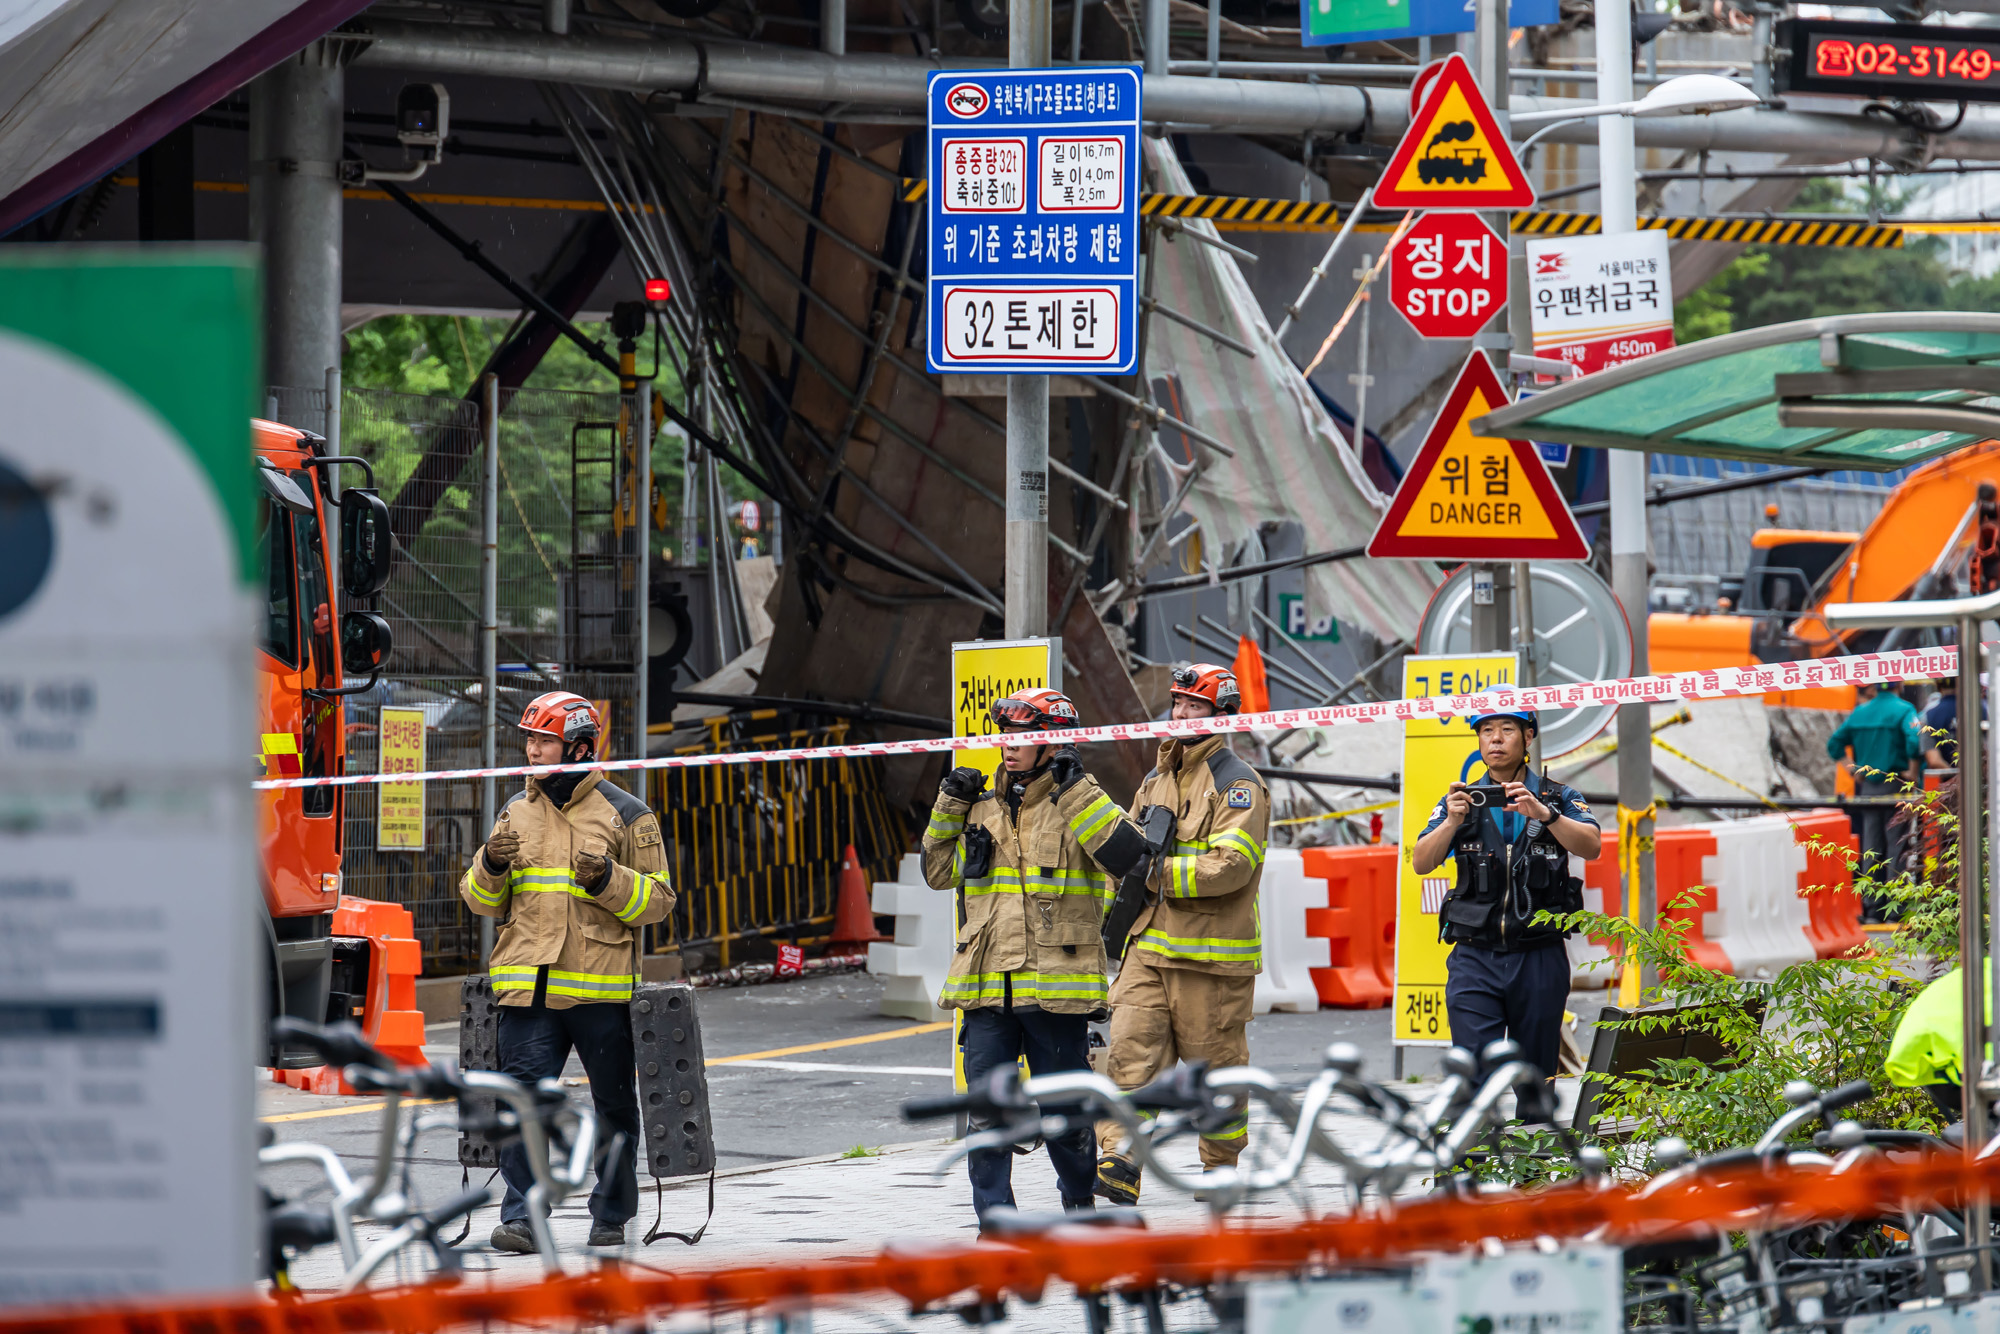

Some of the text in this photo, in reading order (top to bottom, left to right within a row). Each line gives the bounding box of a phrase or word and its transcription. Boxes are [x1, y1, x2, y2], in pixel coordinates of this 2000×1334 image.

[943, 223, 1122, 263] 위 기준 초과차량 제한
[1406, 233, 1490, 280] 정지
[1598, 258, 1659, 277] 서울미근동
[1406, 288, 1491, 317] STOP
[1535, 280, 1659, 318] 우편취급국
[1608, 340, 1657, 357] 450m
[1440, 455, 1509, 497] 위험
[1430, 502, 1522, 526] DANGER
